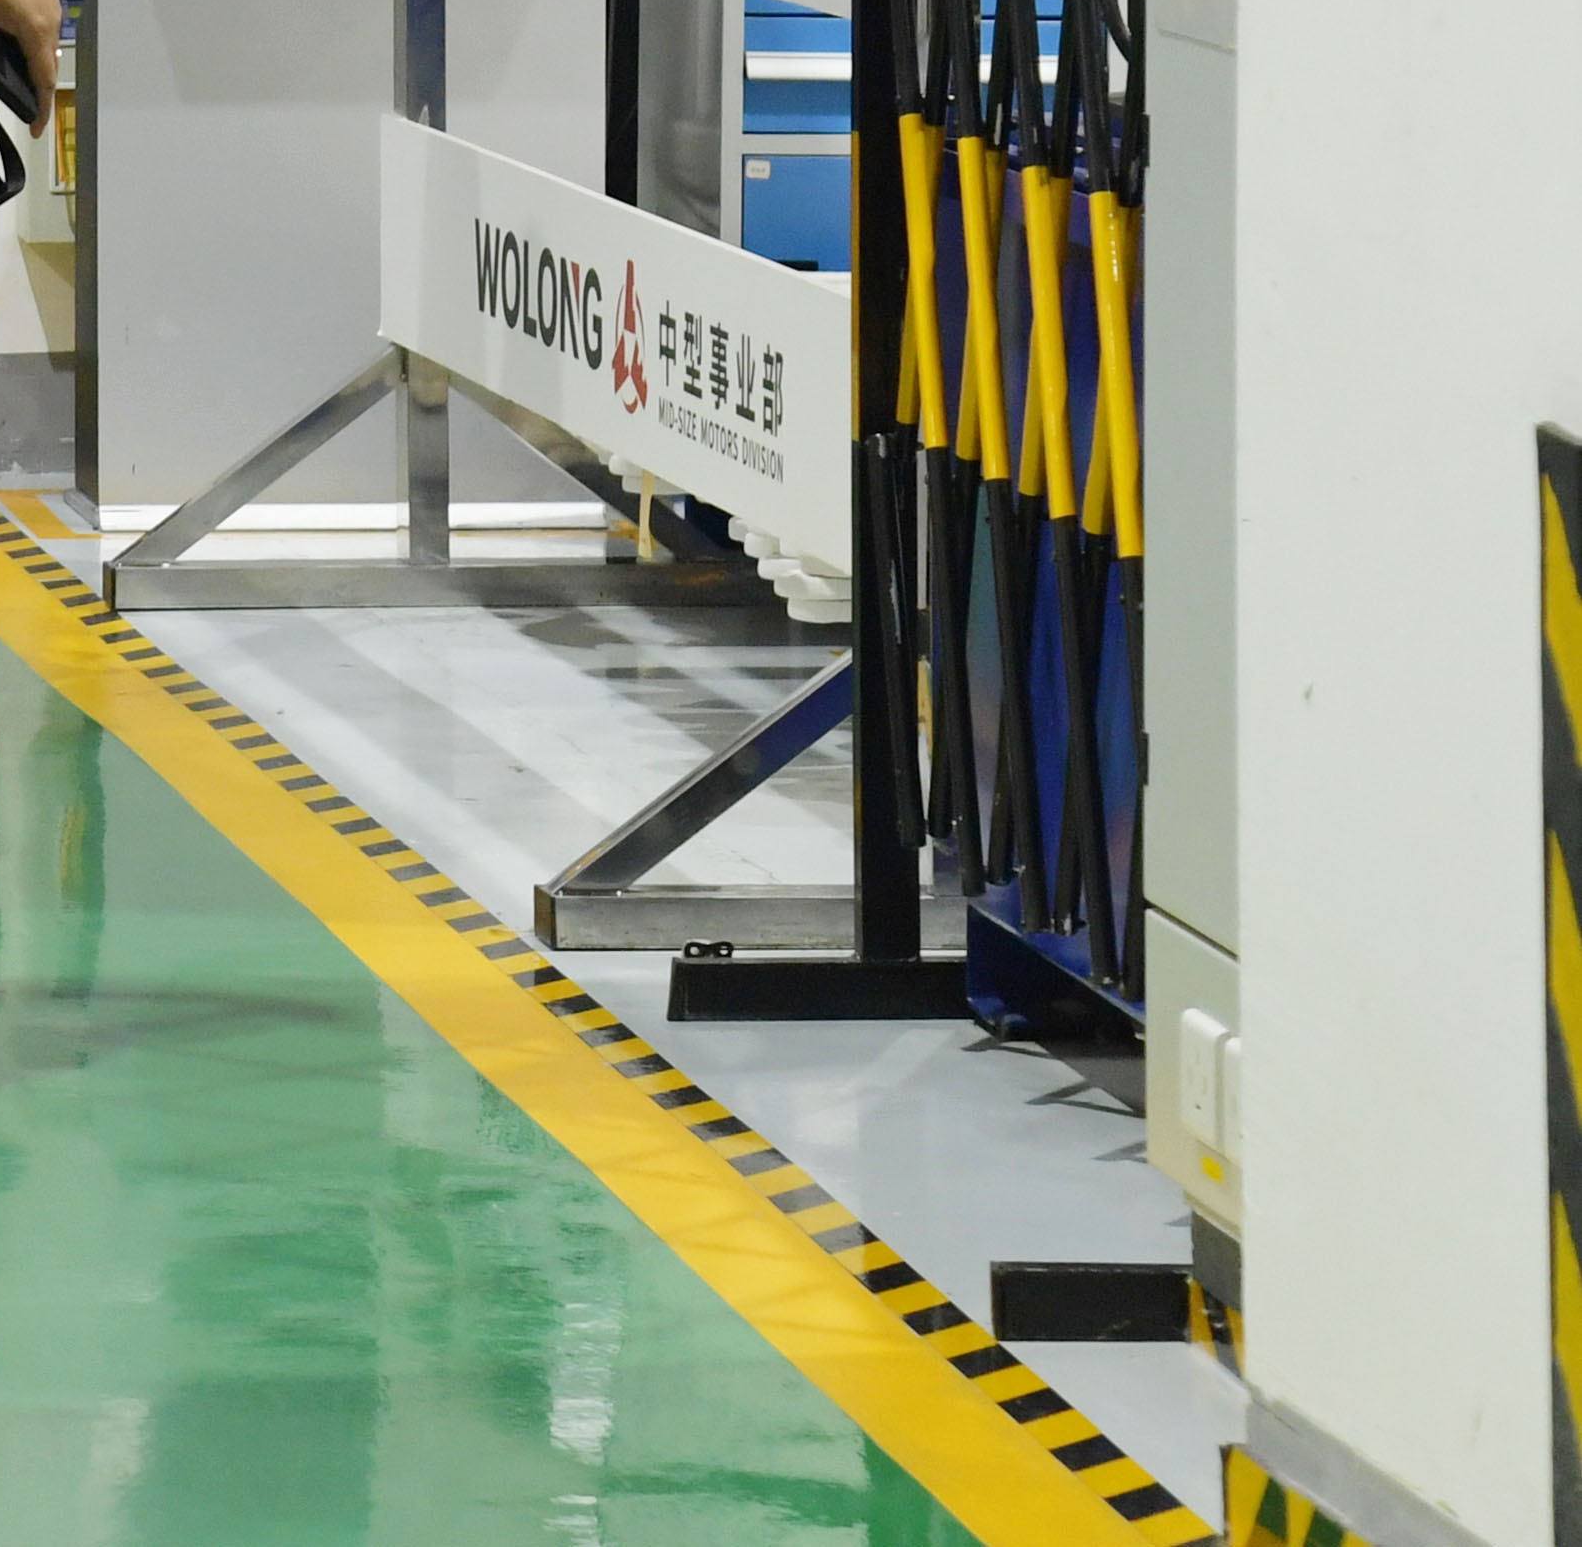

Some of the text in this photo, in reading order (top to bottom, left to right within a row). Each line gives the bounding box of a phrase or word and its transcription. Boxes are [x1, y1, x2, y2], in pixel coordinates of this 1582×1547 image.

[474, 217, 603, 370] WOLONG
[658, 300, 784, 438] 中型事业部
[658, 396, 784, 484] MID-SIZE MOTORS DIVISION
